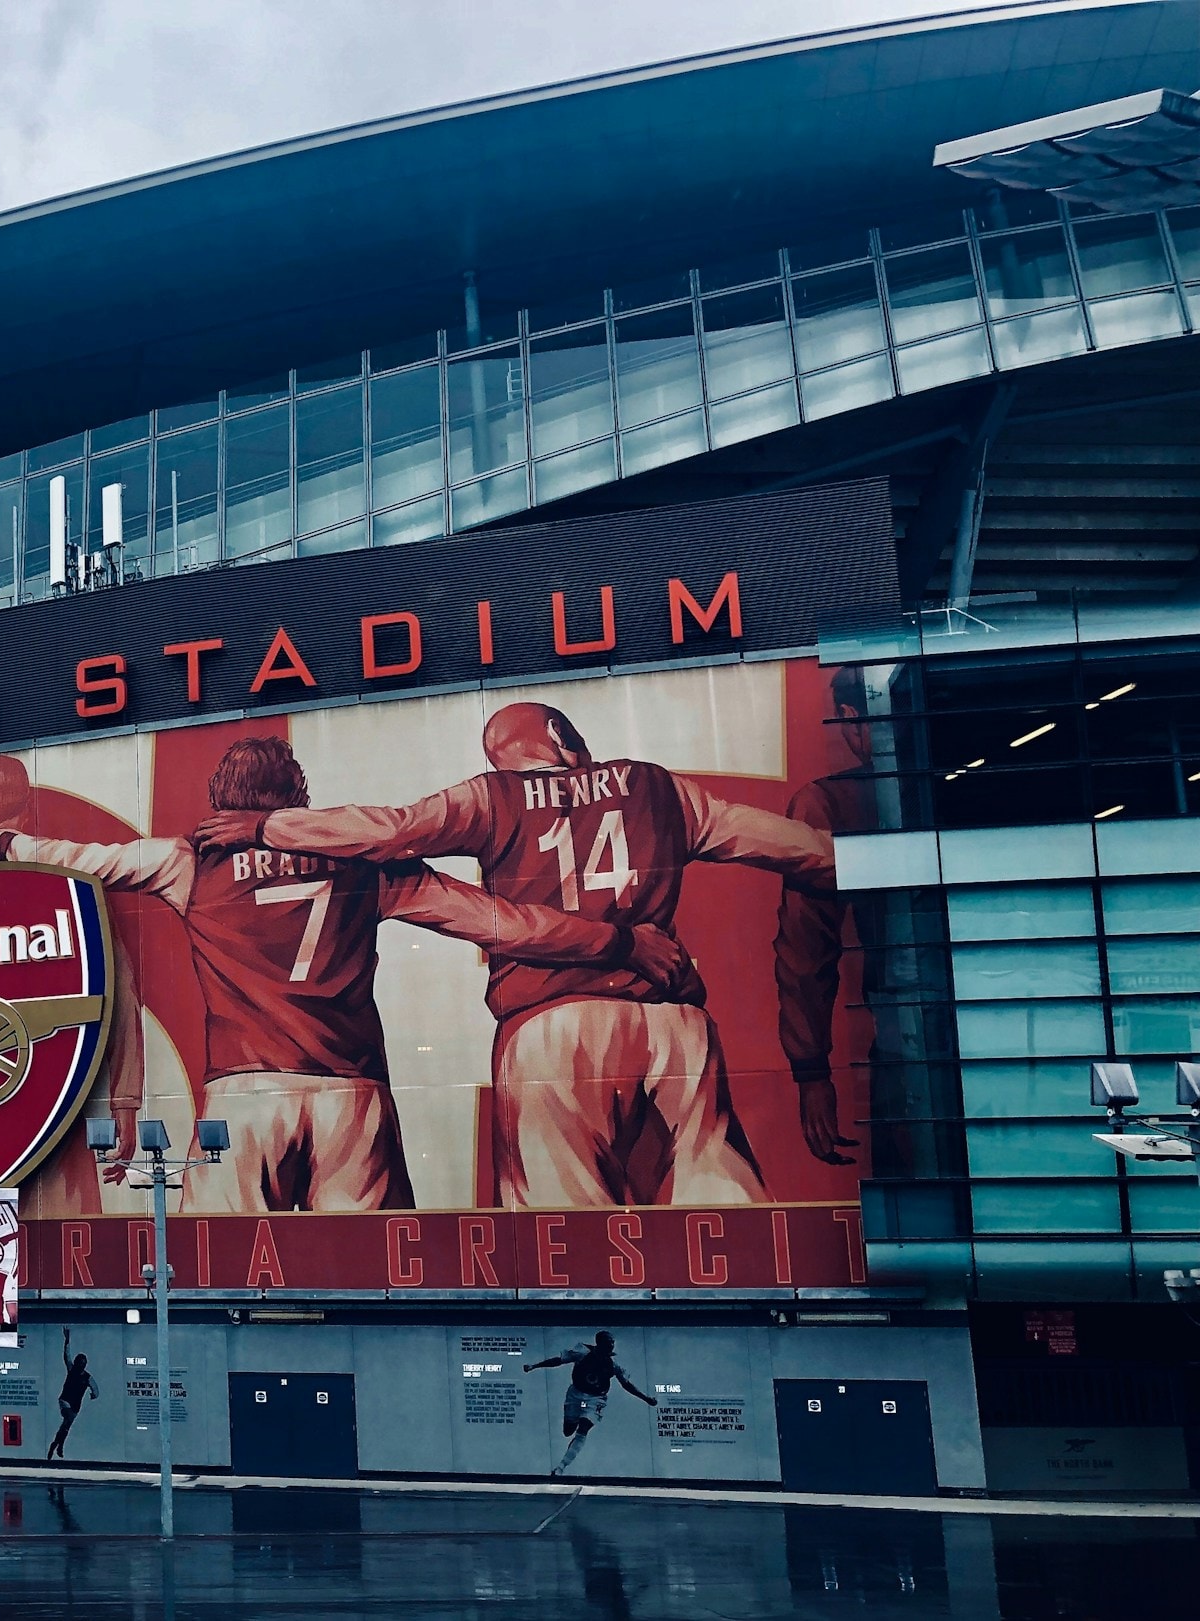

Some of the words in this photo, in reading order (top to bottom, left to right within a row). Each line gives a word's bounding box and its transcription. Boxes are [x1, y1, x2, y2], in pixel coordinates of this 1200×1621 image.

[74, 571, 743, 719] STADIUM
[523, 765, 632, 810] HENRY
[538, 810, 639, 911] 14
[254, 879, 334, 982] 7
[386, 1208, 866, 1287] CRESCIT
